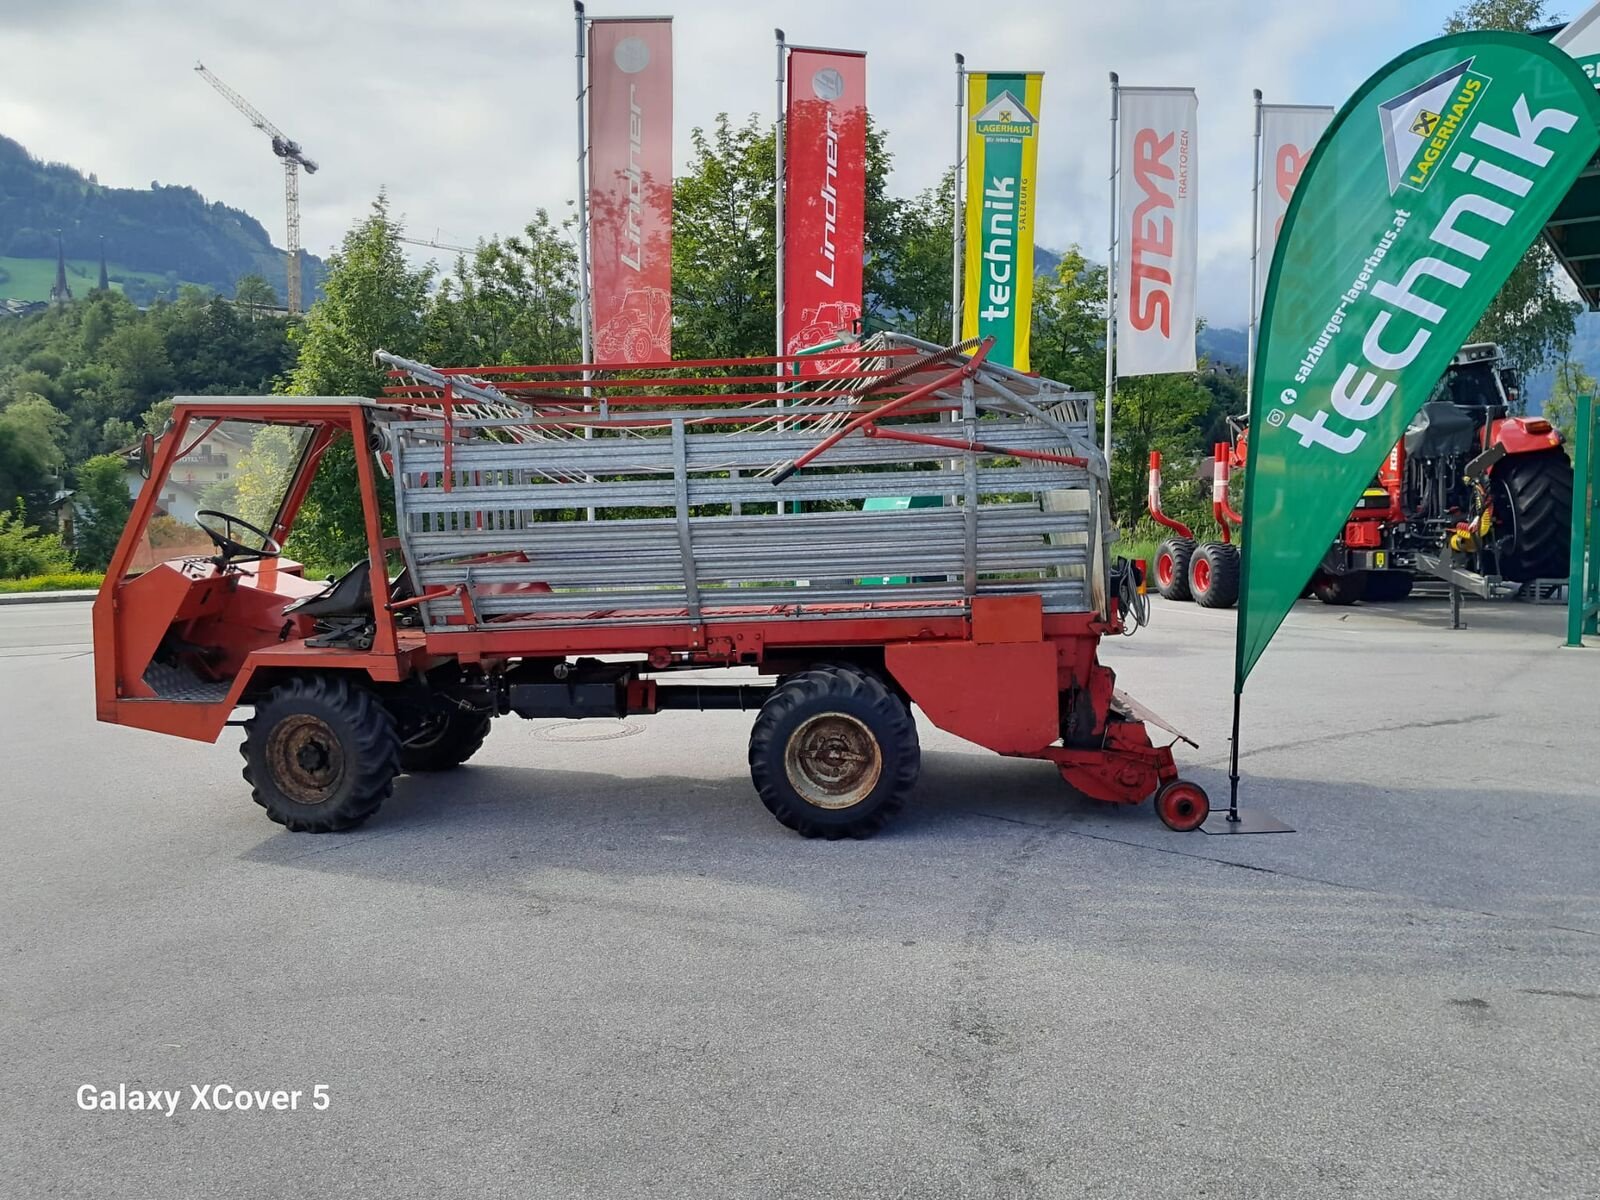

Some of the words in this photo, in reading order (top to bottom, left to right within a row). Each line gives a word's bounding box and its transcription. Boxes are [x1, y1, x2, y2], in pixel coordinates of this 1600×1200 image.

[621, 83, 644, 272] Lindner
[815, 111, 842, 288] Lindner
[978, 124, 1031, 134] LAGERHAUS
[1018, 178, 1028, 231] SALZBURG
[1178, 129, 1189, 201] TRAKTOREN
[1409, 78, 1482, 184] LAGERHAUS
[981, 176, 1015, 322] technik
[1129, 127, 1175, 340] STEYR
[1287, 92, 1580, 455] technik
[1294, 208, 1411, 384] salzburger-lagerhaus.at
